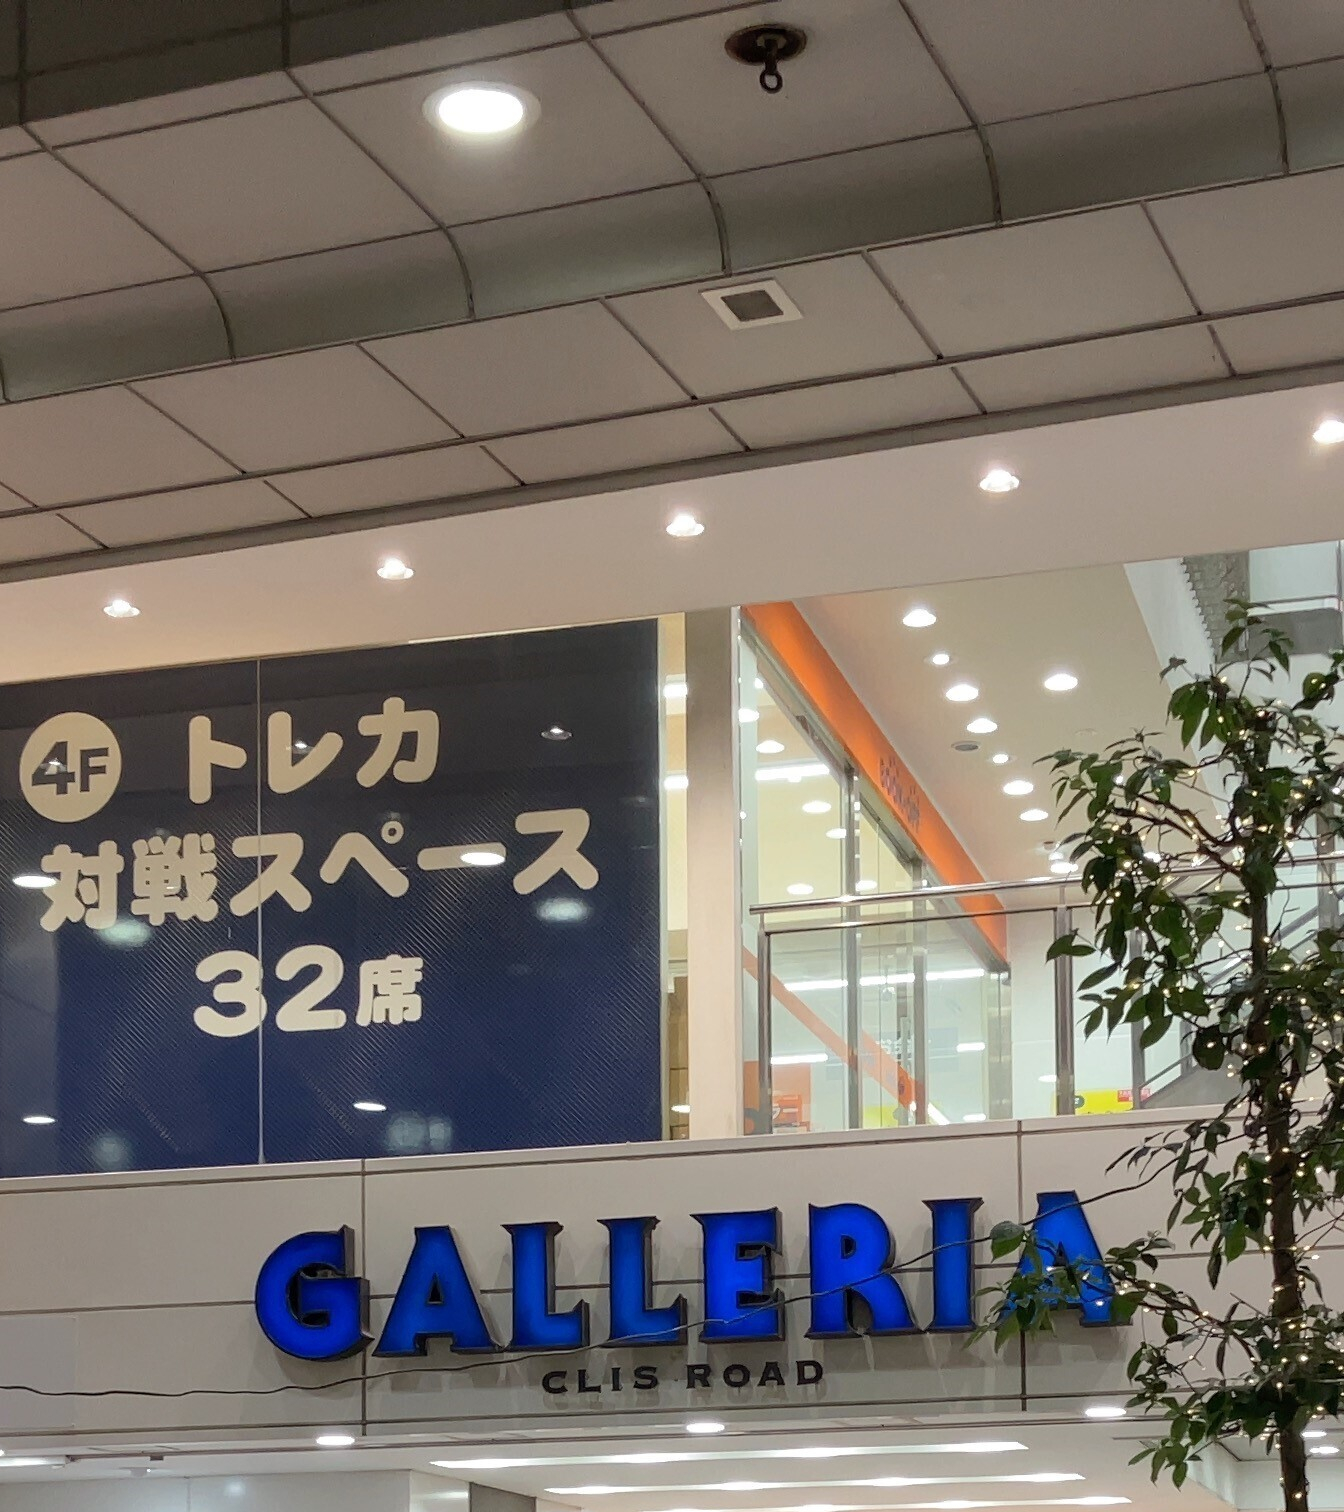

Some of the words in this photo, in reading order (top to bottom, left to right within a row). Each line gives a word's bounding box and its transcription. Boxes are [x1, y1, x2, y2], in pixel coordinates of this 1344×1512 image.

[30, 739, 111, 797] 4F
[188, 696, 441, 804] トレカ
[40, 807, 599, 932] 対戦スペース
[193, 944, 424, 1038] 32席
[255, 1189, 1135, 1360] GALLERIA
[541, 1367, 660, 1395] CLIS
[685, 1359, 825, 1388] ROAD
